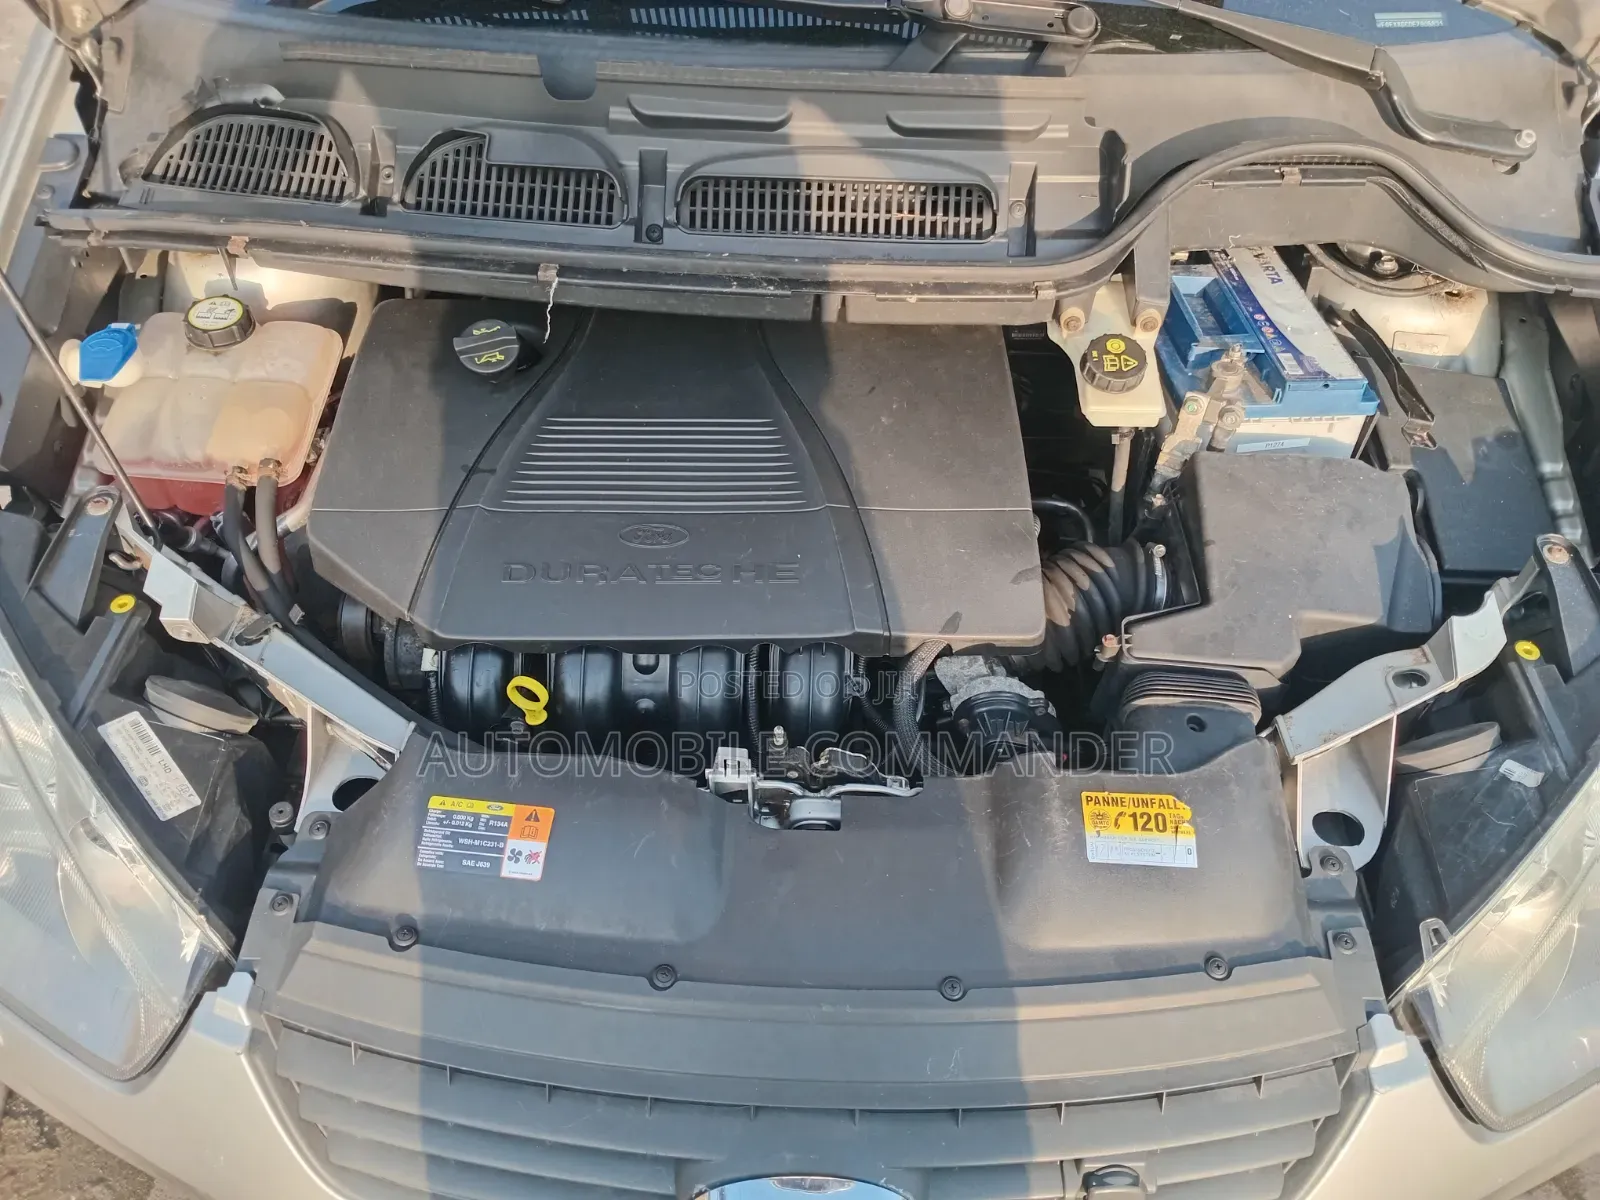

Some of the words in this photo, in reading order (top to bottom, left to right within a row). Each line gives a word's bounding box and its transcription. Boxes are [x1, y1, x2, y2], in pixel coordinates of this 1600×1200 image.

[501, 563, 723, 585] DURATEC
[732, 563, 800, 585] HE
[158, 758, 172, 774] LHD
[488, 820, 508, 828] R134A
[1128, 812, 1168, 833] 120
[1188, 848, 1192, 856] 0
[461, 858, 475, 867] SAE
